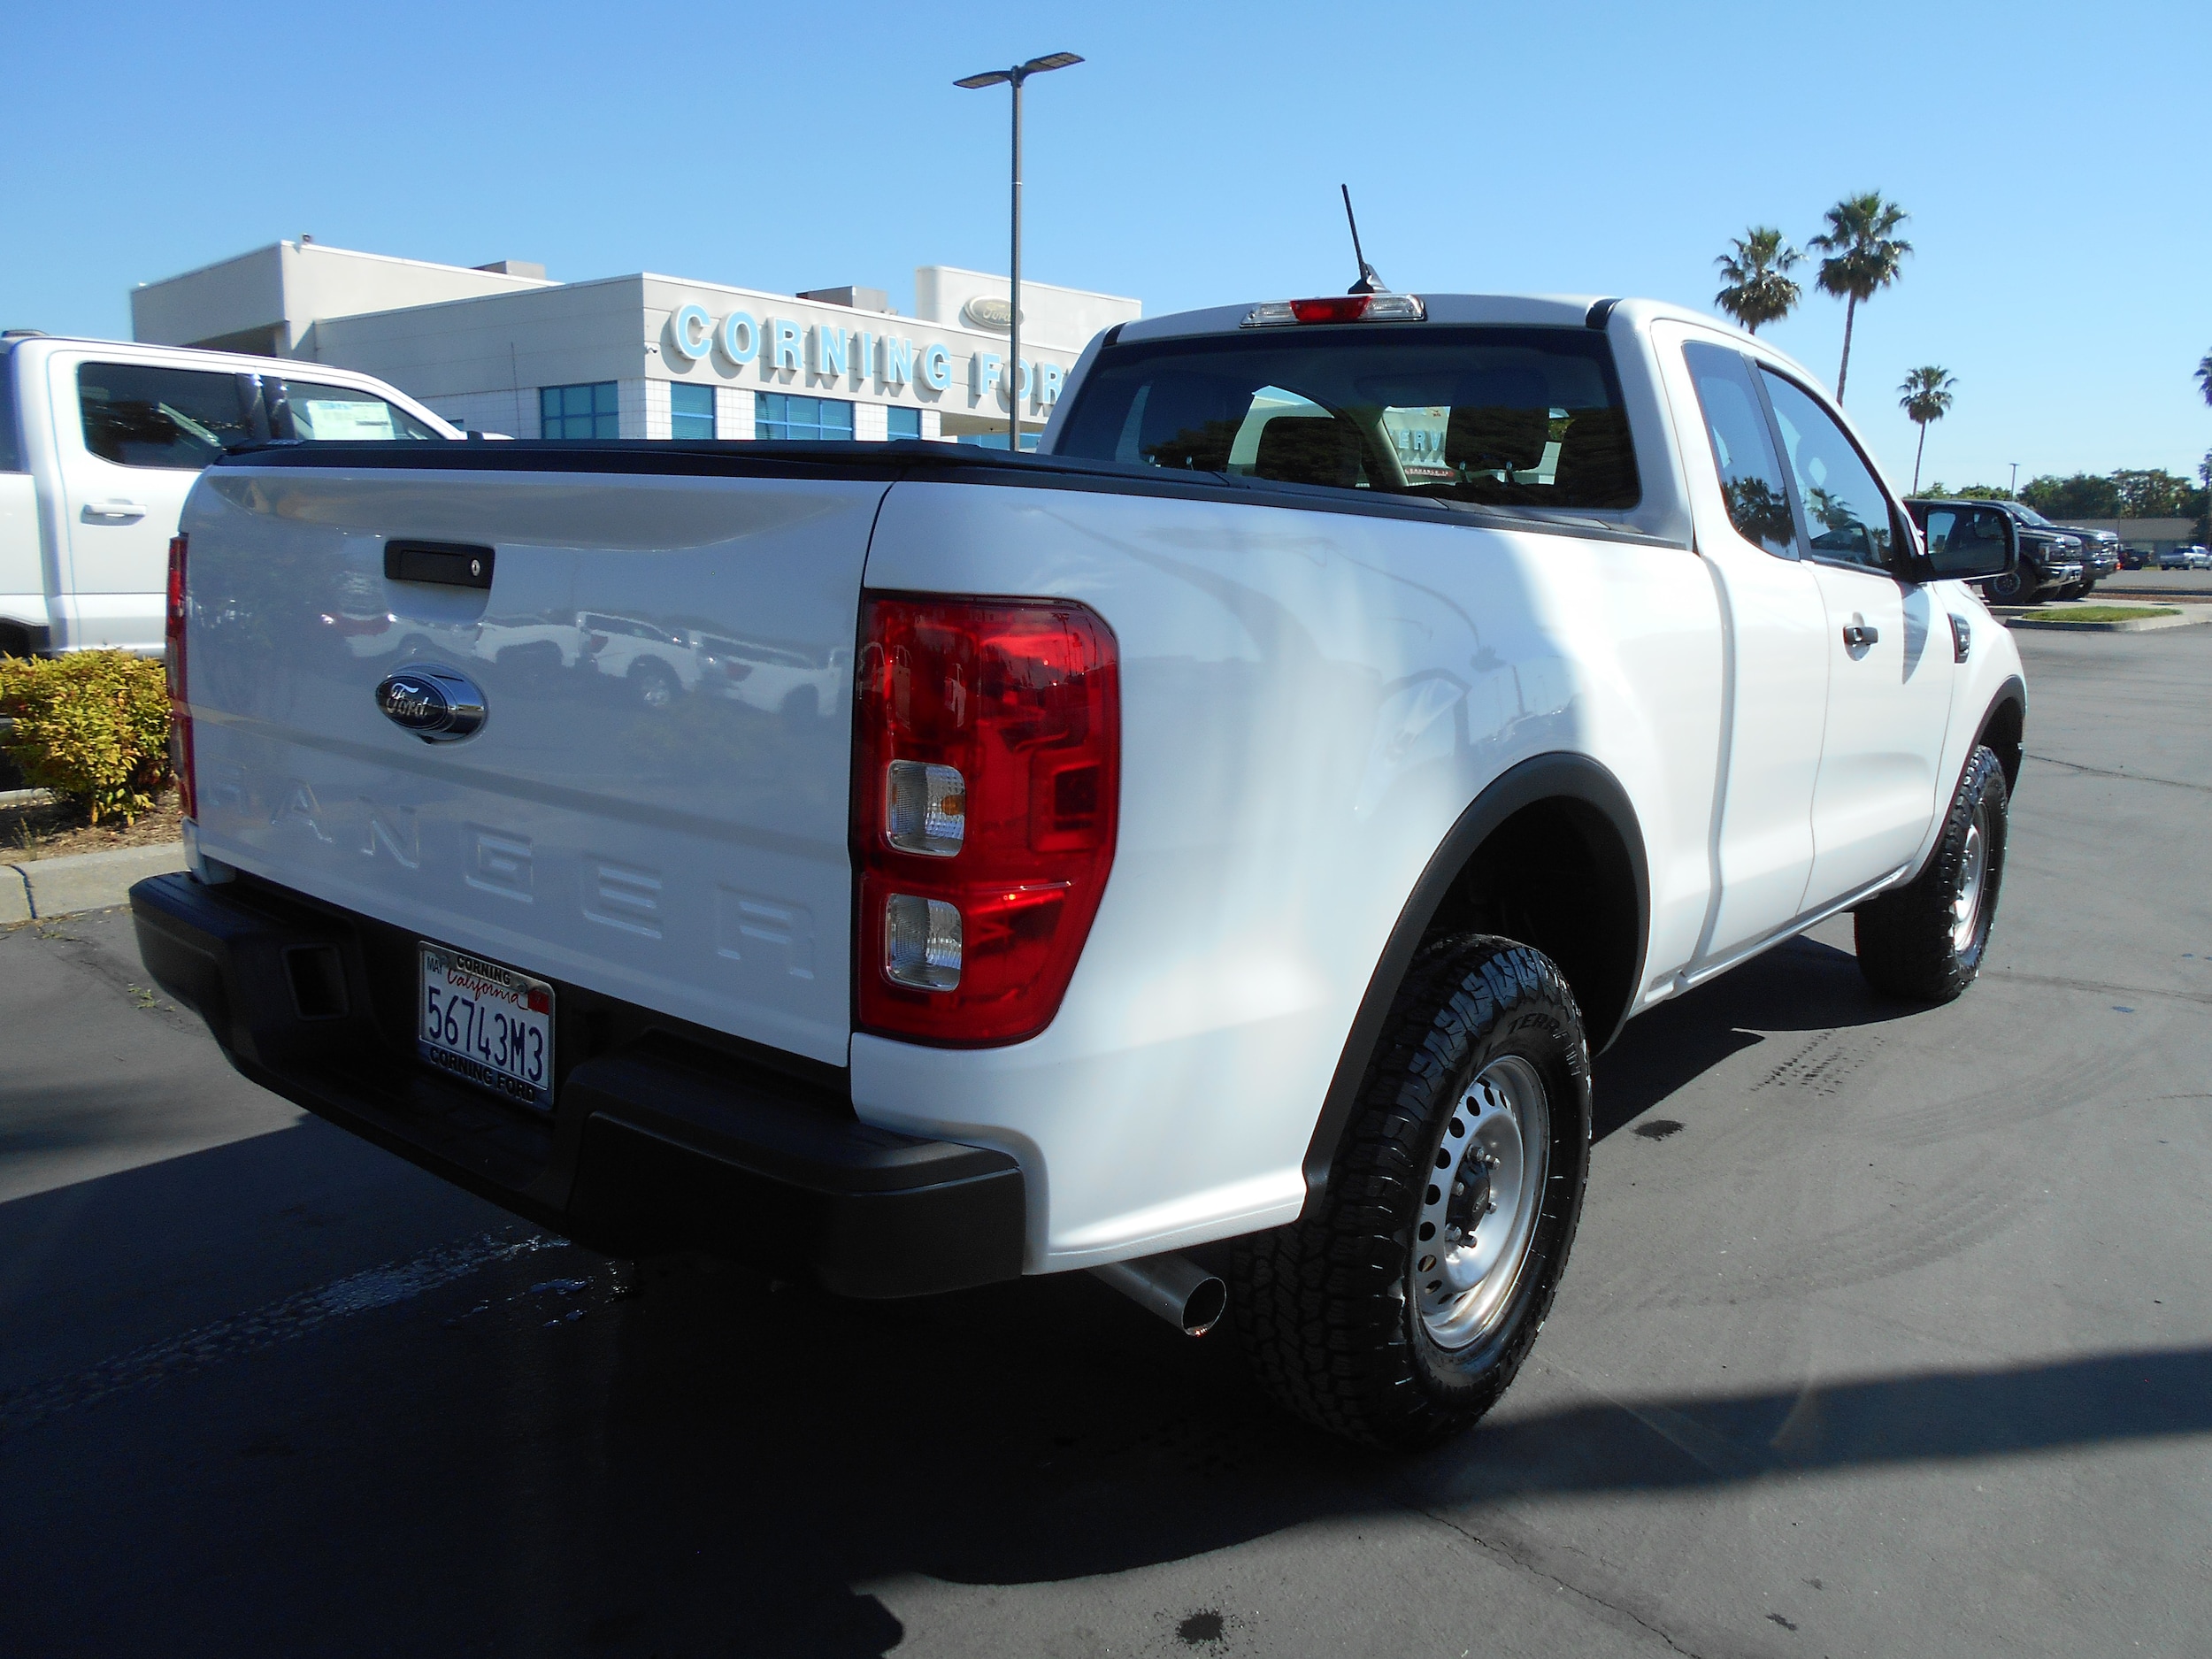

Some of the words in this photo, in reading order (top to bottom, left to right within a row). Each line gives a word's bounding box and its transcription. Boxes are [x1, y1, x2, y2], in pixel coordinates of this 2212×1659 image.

[672, 303, 952, 391] CORNING
[976, 351, 1067, 404] FOR
[1388, 429, 1441, 450] ERV
[387, 682, 428, 718] Ford
[206, 754, 816, 980] RANGER
[447, 968, 528, 1010] California
[456, 955, 511, 987] CORNING
[428, 986, 543, 1081] 56743M3
[429, 1046, 493, 1086] CORNING
[496, 1076, 535, 1104] FORD
